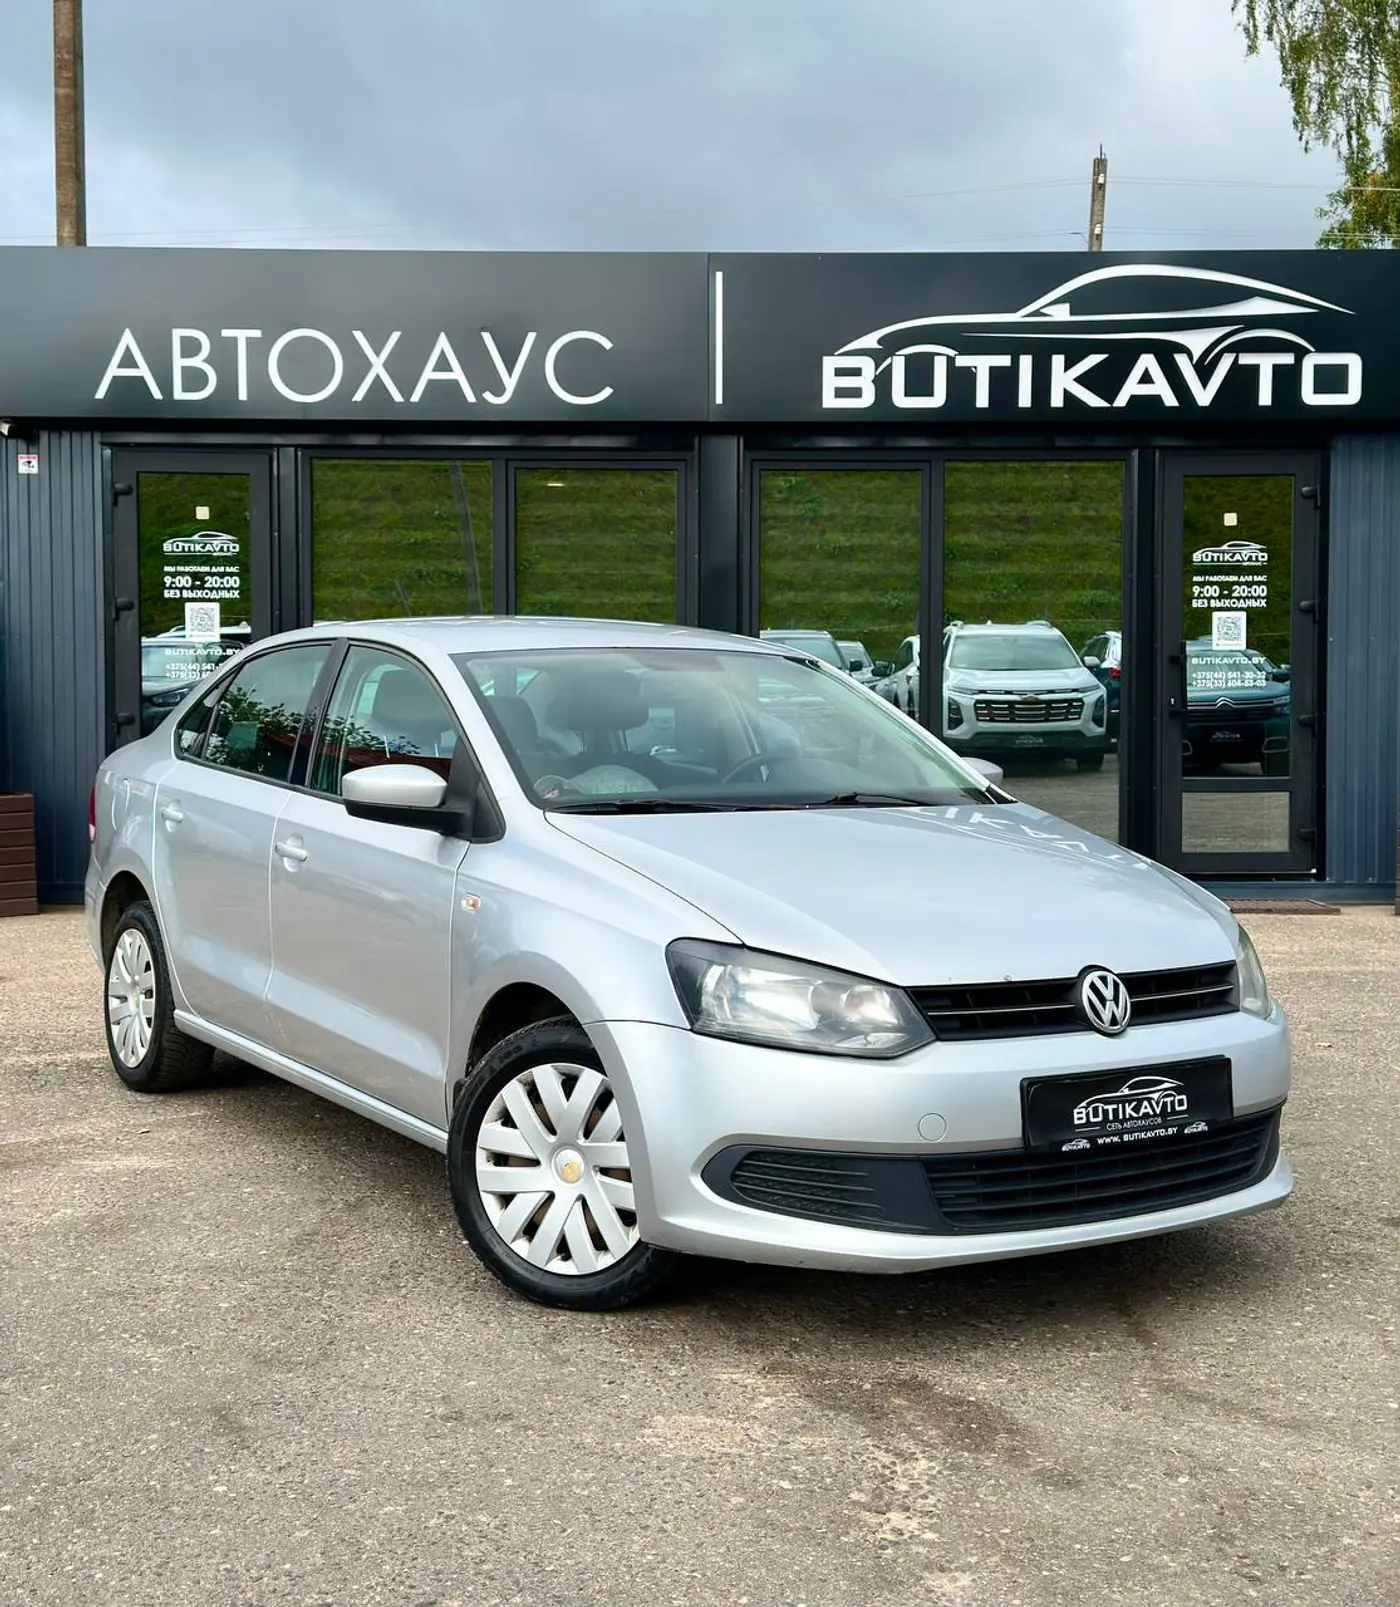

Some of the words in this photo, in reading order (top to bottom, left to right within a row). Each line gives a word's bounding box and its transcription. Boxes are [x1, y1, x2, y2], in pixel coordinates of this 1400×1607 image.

[94, 327, 615, 406] АВТОХАУС
[821, 352, 1364, 410] BUTIKAVTO
[163, 542, 240, 552] BUTIKAVTO
[1192, 552, 1268, 562] BUTIKAVTO
[163, 575, 192, 588] 9:00
[204, 575, 240, 588] 20:00
[163, 589, 181, 598] БЕЗ
[182, 589, 240, 599] ВЫХОДНЫХ
[1192, 585, 1220, 597] 9:00
[1232, 585, 1268, 597] 20:00
[1192, 598, 1208, 608] БЕЗ
[1210, 598, 1267, 609] ВЫХОДНЫХ
[1073, 1094, 1188, 1125] BUTIKAVTO
[1106, 1119, 1122, 1131] СЕТЬ
[1123, 1116, 1163, 1129] АВТОХАУСОВ
[1123, 1126, 1178, 1142] BUTIKAVTO.BY
